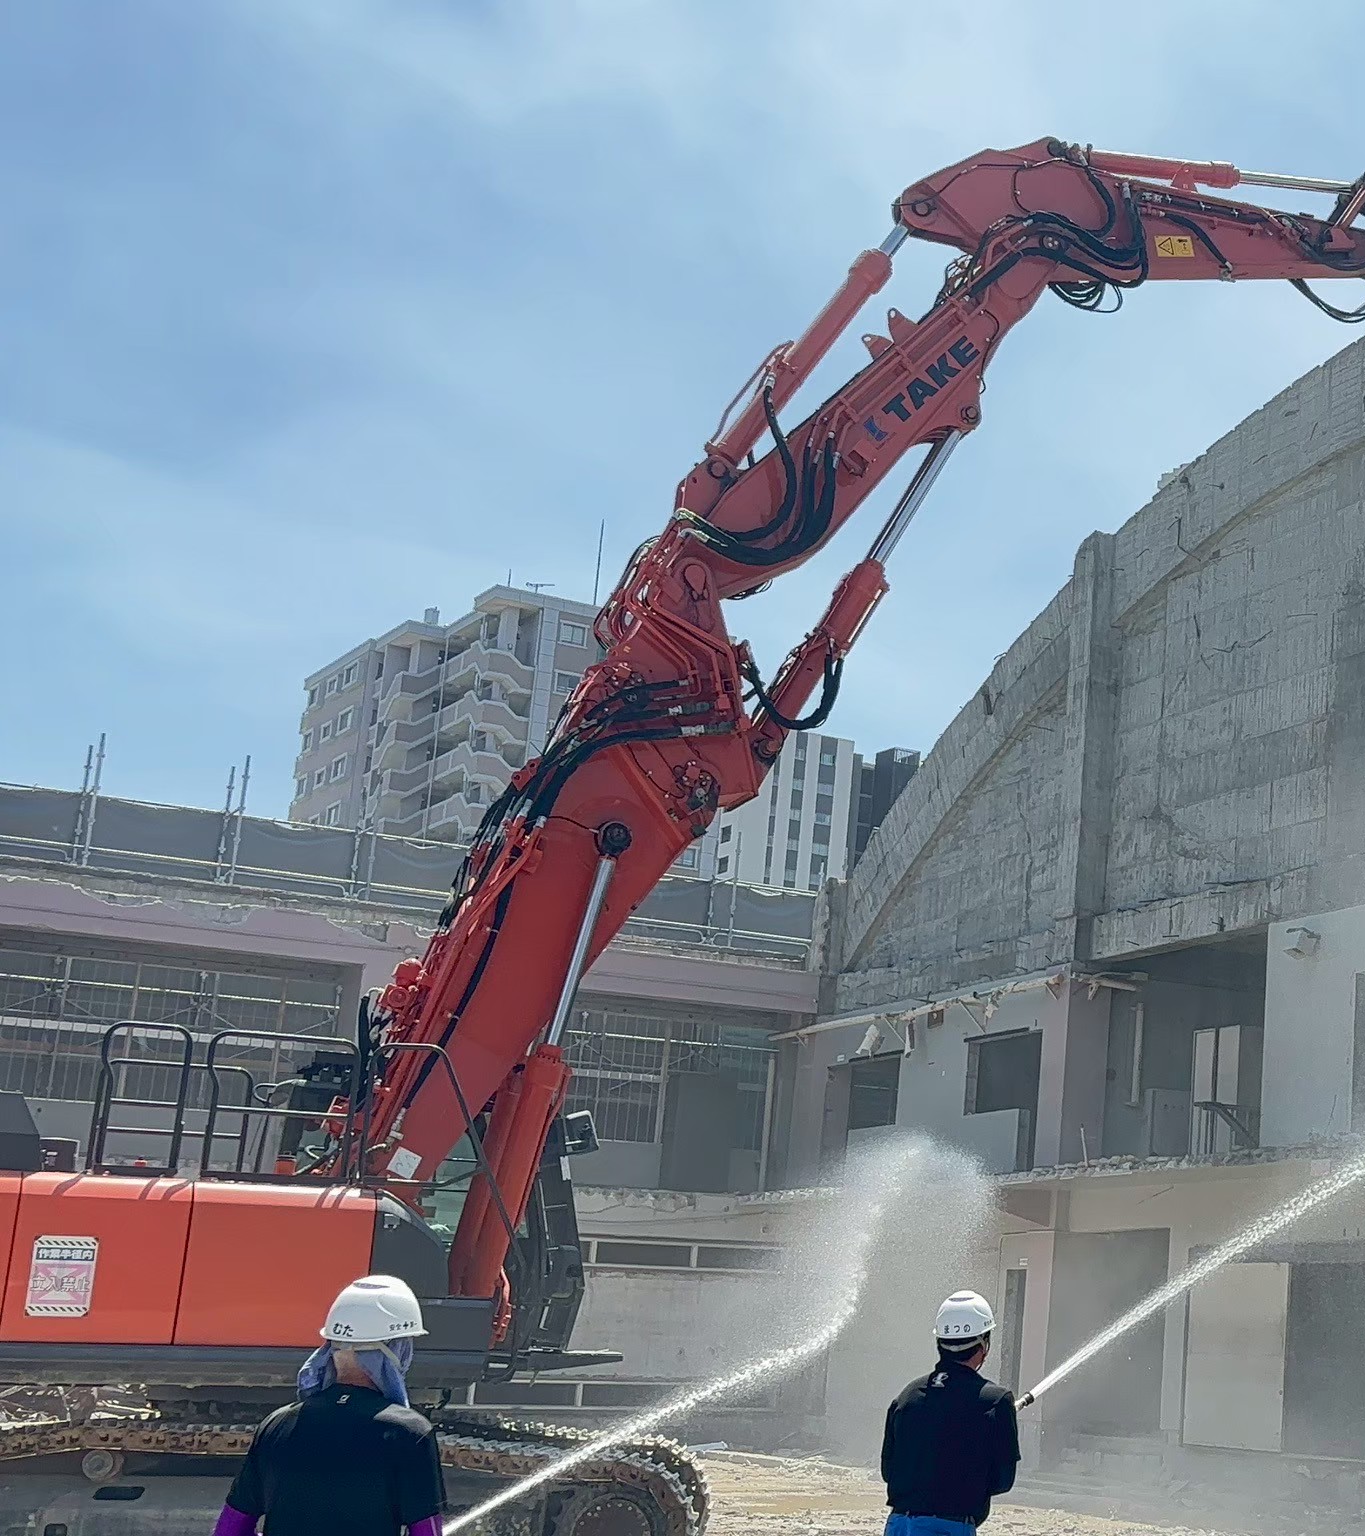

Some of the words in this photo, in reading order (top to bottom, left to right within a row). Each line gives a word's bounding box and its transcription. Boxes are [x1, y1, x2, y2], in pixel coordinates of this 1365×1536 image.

[882, 335, 980, 422] TAKE
[30, 1275, 90, 1292] 立入禁止
[332, 1322, 354, 1337] むた
[944, 1324, 971, 1334] まつの
